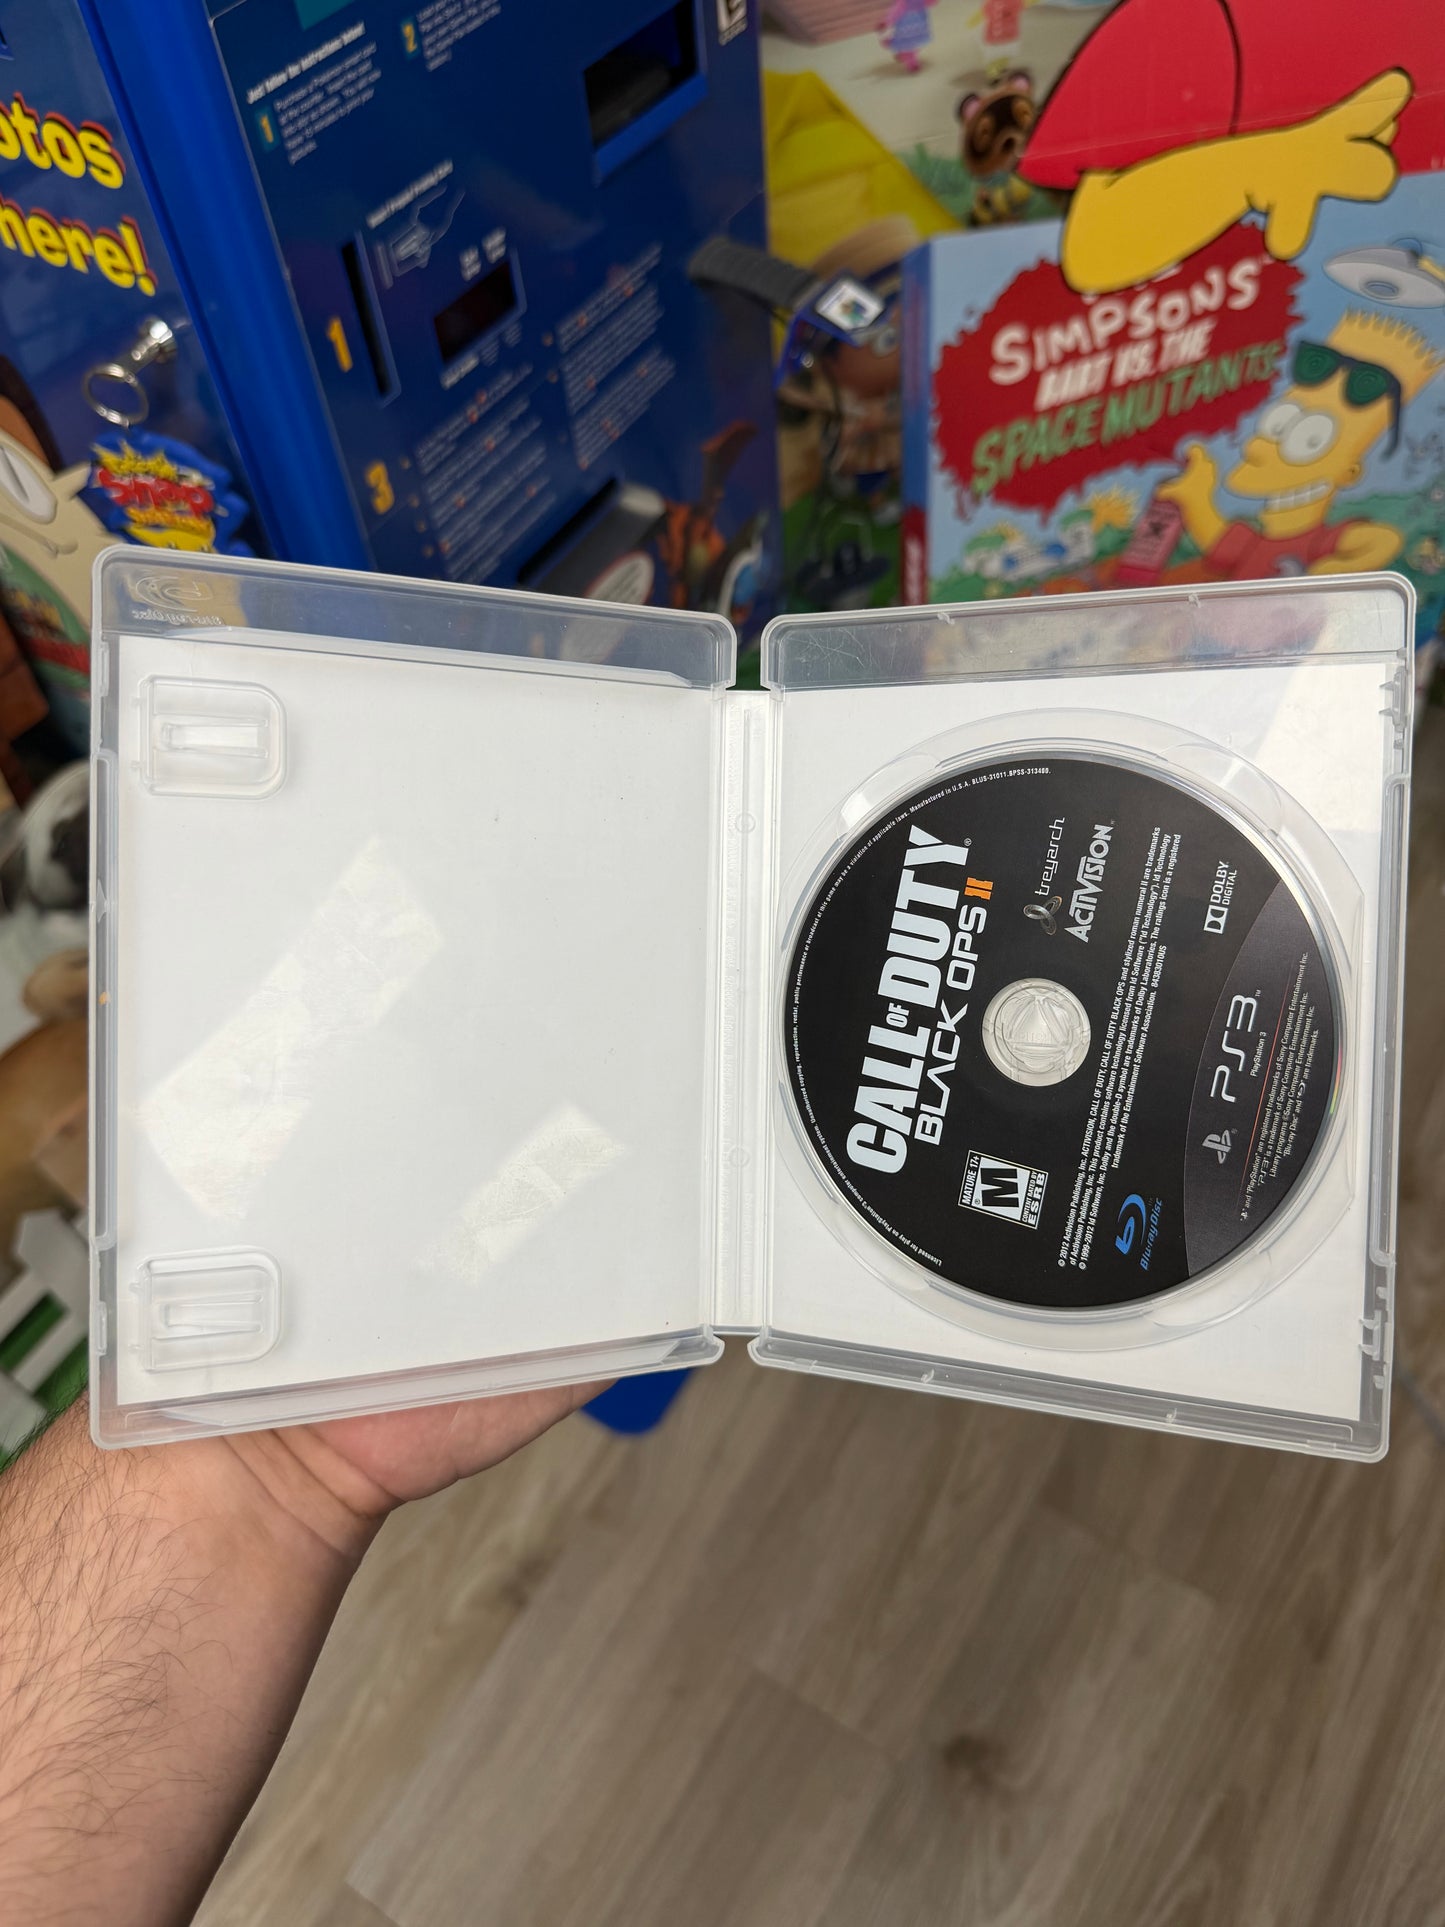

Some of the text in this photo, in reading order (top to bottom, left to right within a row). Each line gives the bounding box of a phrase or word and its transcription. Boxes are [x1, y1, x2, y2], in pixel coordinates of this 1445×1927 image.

[988, 256, 1262, 386] SIMPSONS
[971, 338, 1285, 494] SPACE MUTANTS
[364, 459, 396, 516] 3
[1034, 816, 1066, 896] treyarch
[1144, 825, 1161, 867] trademarks
[1153, 832, 1172, 874] Technology
[1165, 833, 1182, 870] registered
[1158, 883, 1170, 900] icon
[1210, 860, 1230, 904] DOLBY
[1222, 870, 1238, 906] DIGITAL
[1133, 886, 1147, 916] numeral
[1153, 900, 1167, 926] ratings
[1129, 916, 1140, 939] roman
[1122, 939, 1136, 967] stylized
[1130, 944, 1145, 976] Software
[1139, 939, 1157, 985] Laboratories.
[1110, 995, 1122, 1020] BLACK
[1125, 984, 1136, 1002] from
[1135, 985, 1148, 1006] Dolby
[886, 1002, 910, 1028] OF
[914, 999, 969, 1146] BLACK
[946, 904, 988, 992] OPS
[1106, 1019, 1117, 1039] DUTY
[1118, 1002, 1132, 1031] licensed
[1124, 1014, 1140, 1054] trademarks
[1099, 1049, 1110, 1068] CALL
[1110, 1031, 1127, 1070] technology
[1249, 1037, 1266, 1076] PlayStation
[1095, 1067, 1107, 1088] DUTY,
[1103, 1069, 1117, 1100] software
[1110, 1132, 1125, 1168] trademark
[1122, 1063, 1140, 1112] Entertainment
[1133, 1031, 1147, 1063] Software
[1140, 989, 1157, 1032] Association.
[1115, 1066, 1130, 1093] symbol
[846, 1024, 931, 1174] CALL
[1089, 1098, 1100, 1116] CALL
[1108, 1092, 1123, 1124] double-D
[1096, 1100, 1110, 1130] contains
[1080, 1116, 1097, 1157] ACTIVISION,
[1091, 1129, 1105, 1157] product
[1077, 1156, 1087, 1170] Inc.
[1087, 1156, 1098, 1172] This
[1098, 1150, 1112, 1171] Dolby
[962, 1155, 980, 1204] MATURE 17+
[980, 1168, 1020, 1208] M
[1026, 1179, 1036, 1198] RATED
[1069, 1170, 1086, 1208] Publishing,
[1085, 1172, 1095, 1186] Inc.
[1096, 1170, 1106, 1184] Inc.
[1022, 1198, 1032, 1222] CONTENT
[1028, 1172, 1045, 1226] ESRB
[1076, 1185, 1093, 1224] Publishing,
[1088, 1184, 1104, 1217] Software,
[1150, 1198, 1162, 1226] Disc
[1062, 1207, 1076, 1241] Activision
[1058, 1240, 1069, 1258] 2012
[1069, 1223, 1084, 1257] Activision
